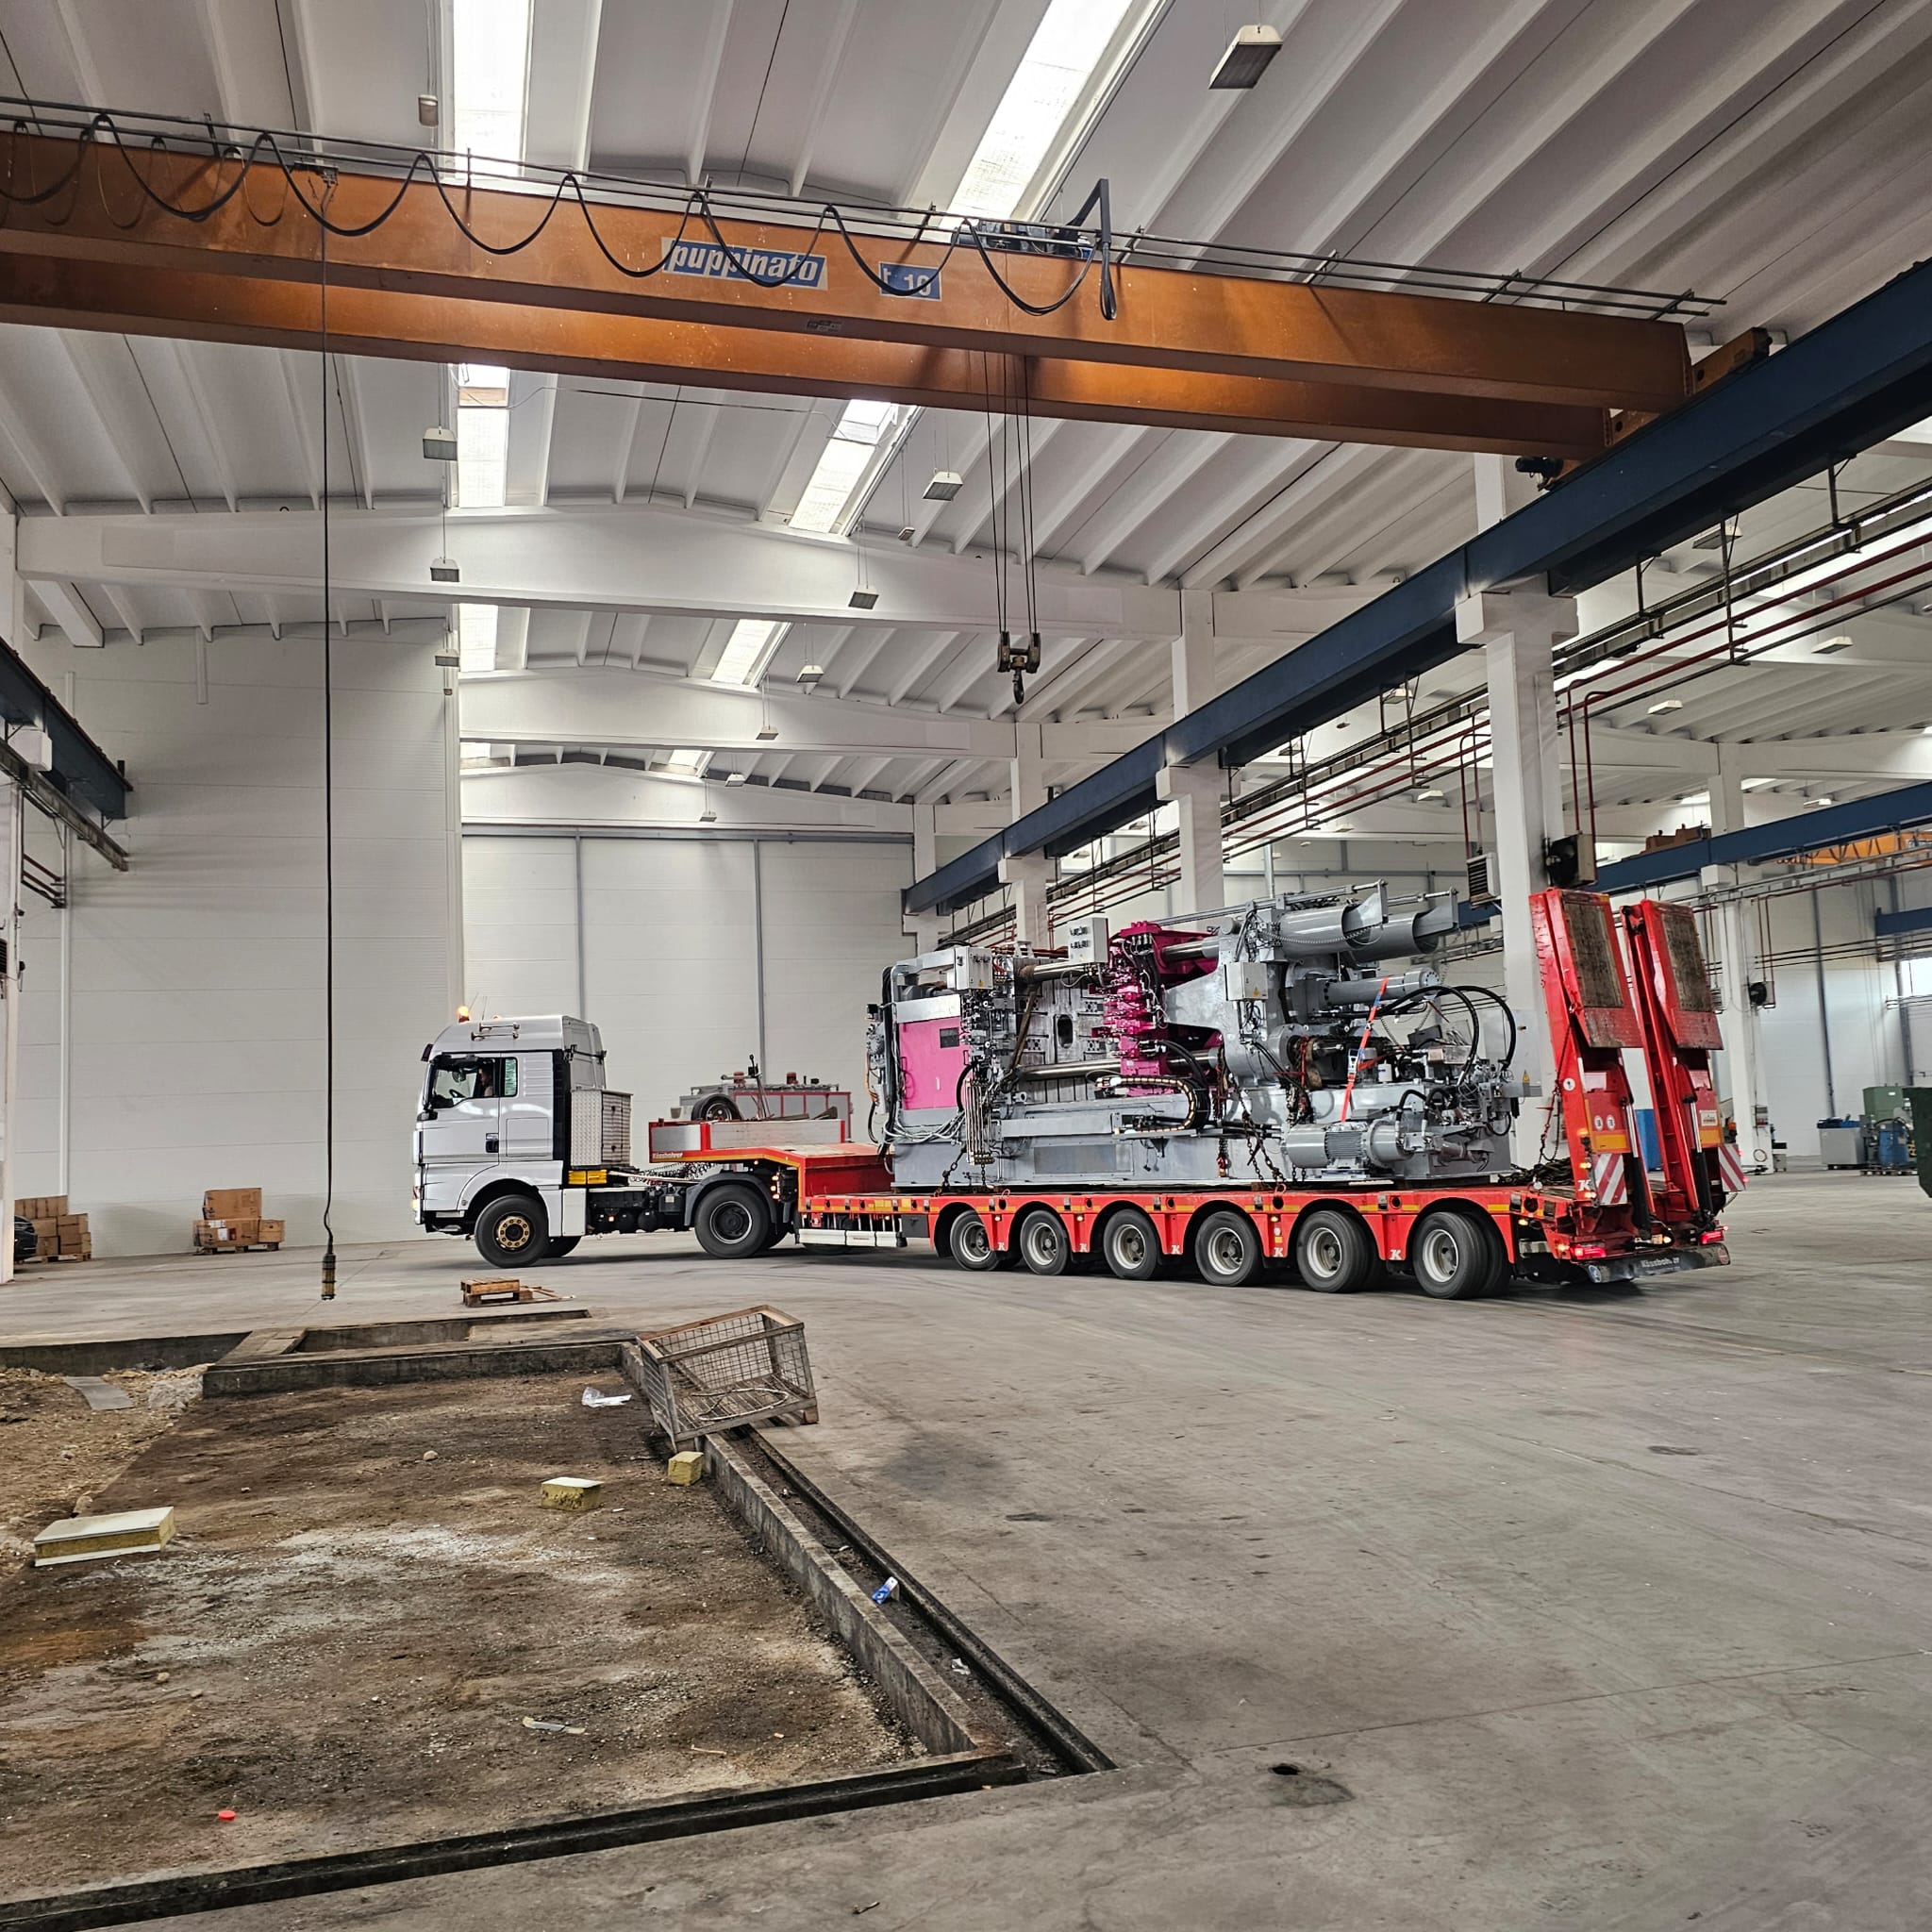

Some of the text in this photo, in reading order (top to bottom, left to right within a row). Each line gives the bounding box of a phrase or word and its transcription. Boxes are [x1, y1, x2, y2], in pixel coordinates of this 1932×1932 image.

[668, 244, 819, 281] puppinato
[903, 274, 931, 296] 10
[1389, 1249, 1402, 1260] K
